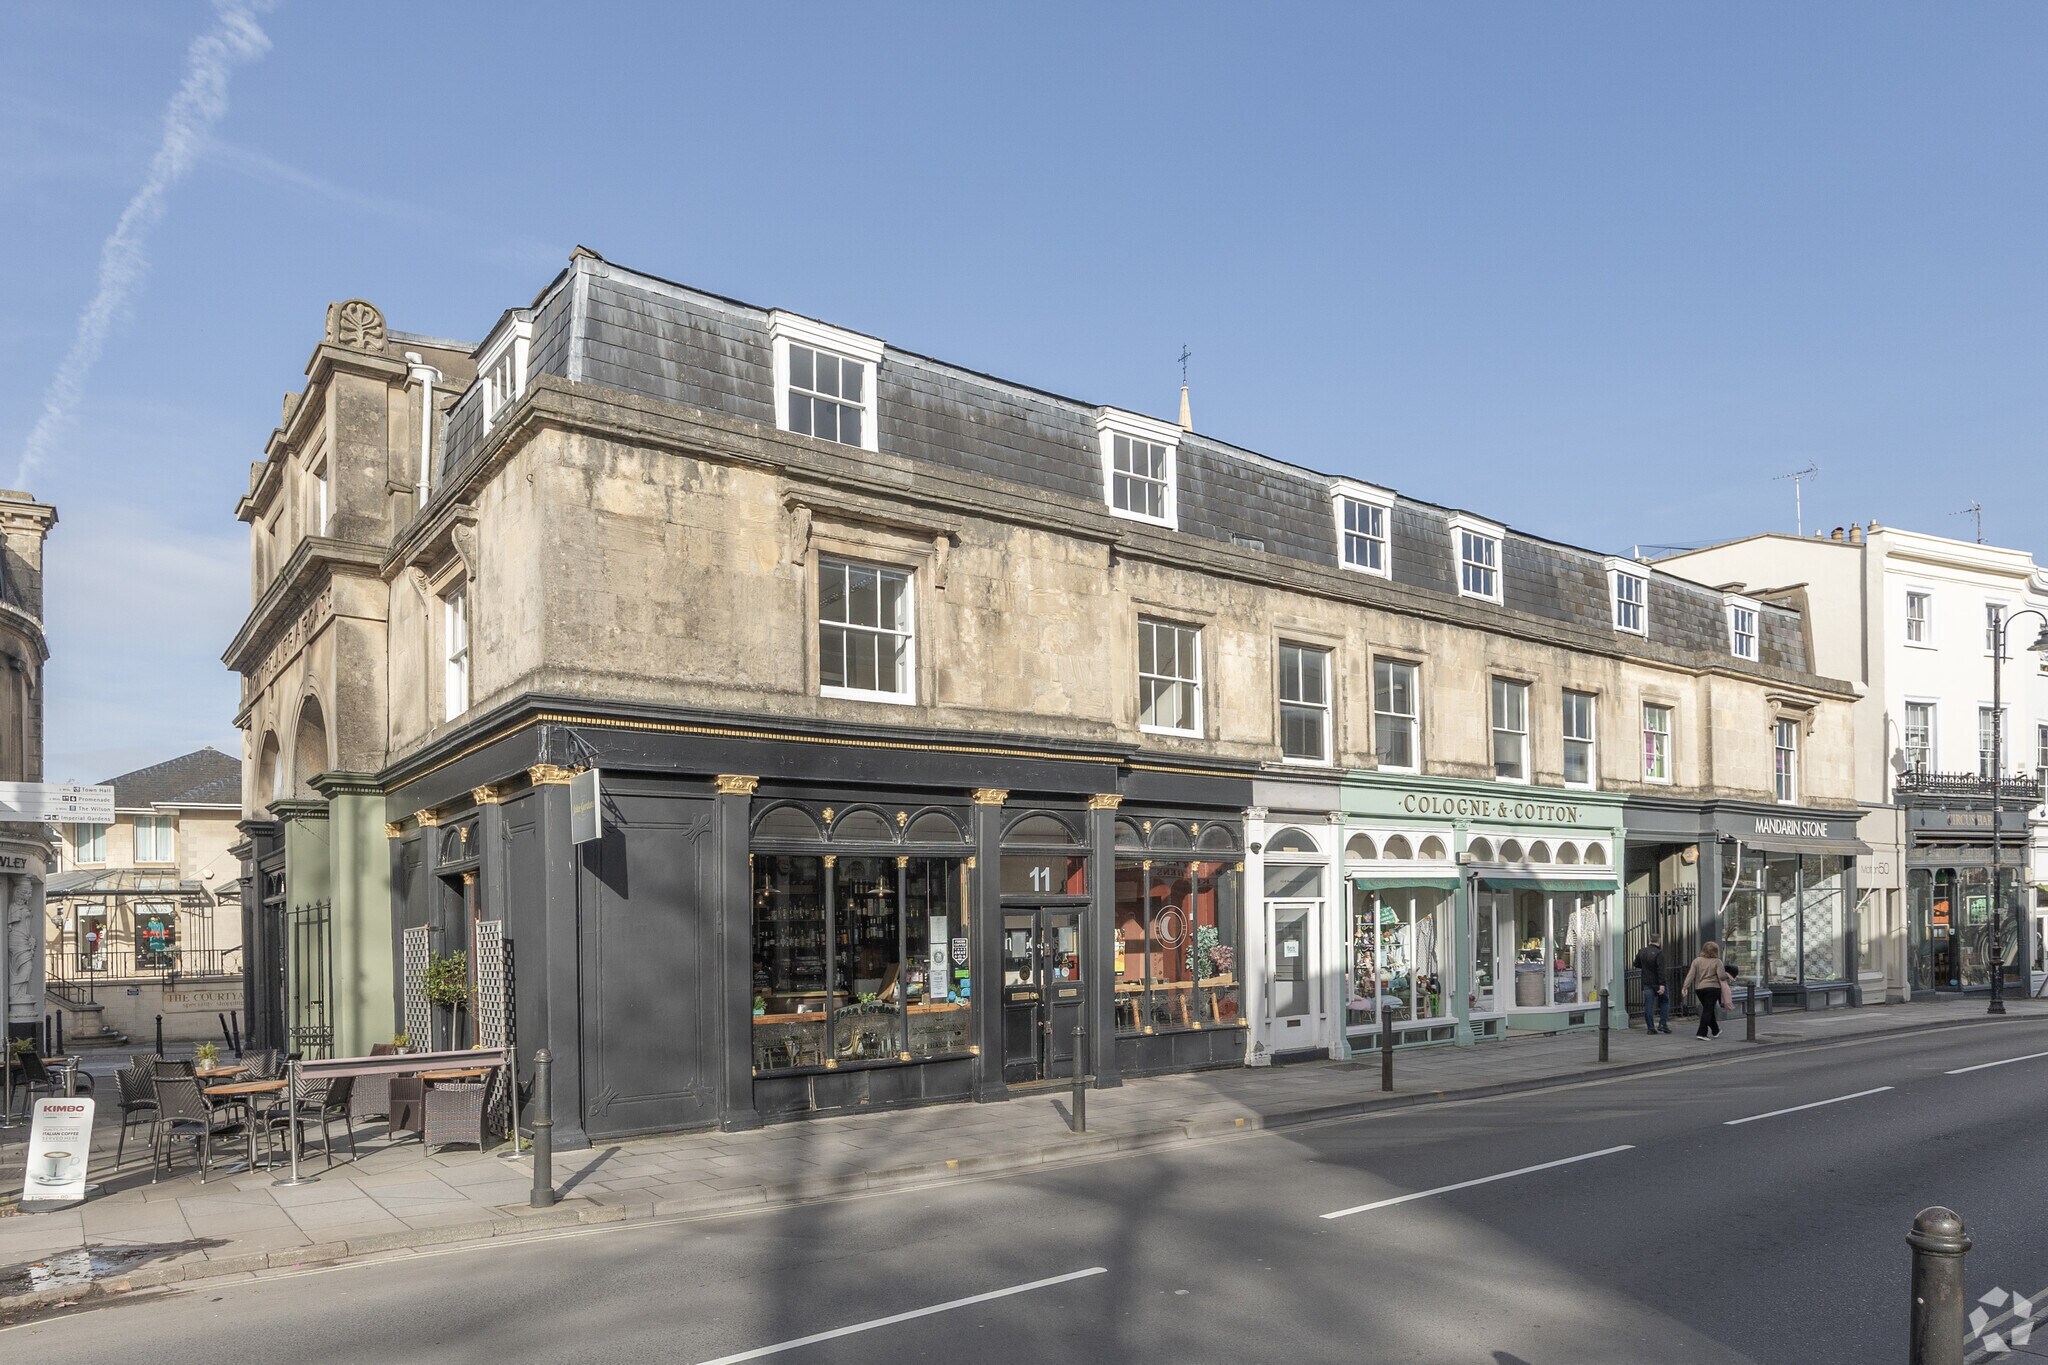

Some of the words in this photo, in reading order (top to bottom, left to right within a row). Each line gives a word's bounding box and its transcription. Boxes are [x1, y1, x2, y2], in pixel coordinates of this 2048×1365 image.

[1404, 794, 1491, 817] COLOGNE
[1497, 802, 1508, 818] &
[1514, 803, 1578, 823] COTTON
[1755, 818, 1800, 835] MANDARIN
[1802, 821, 1828, 837] STONE
[1977, 814, 1994, 826] BAR
[1029, 866, 1051, 892] 11
[168, 994, 190, 1003] THE
